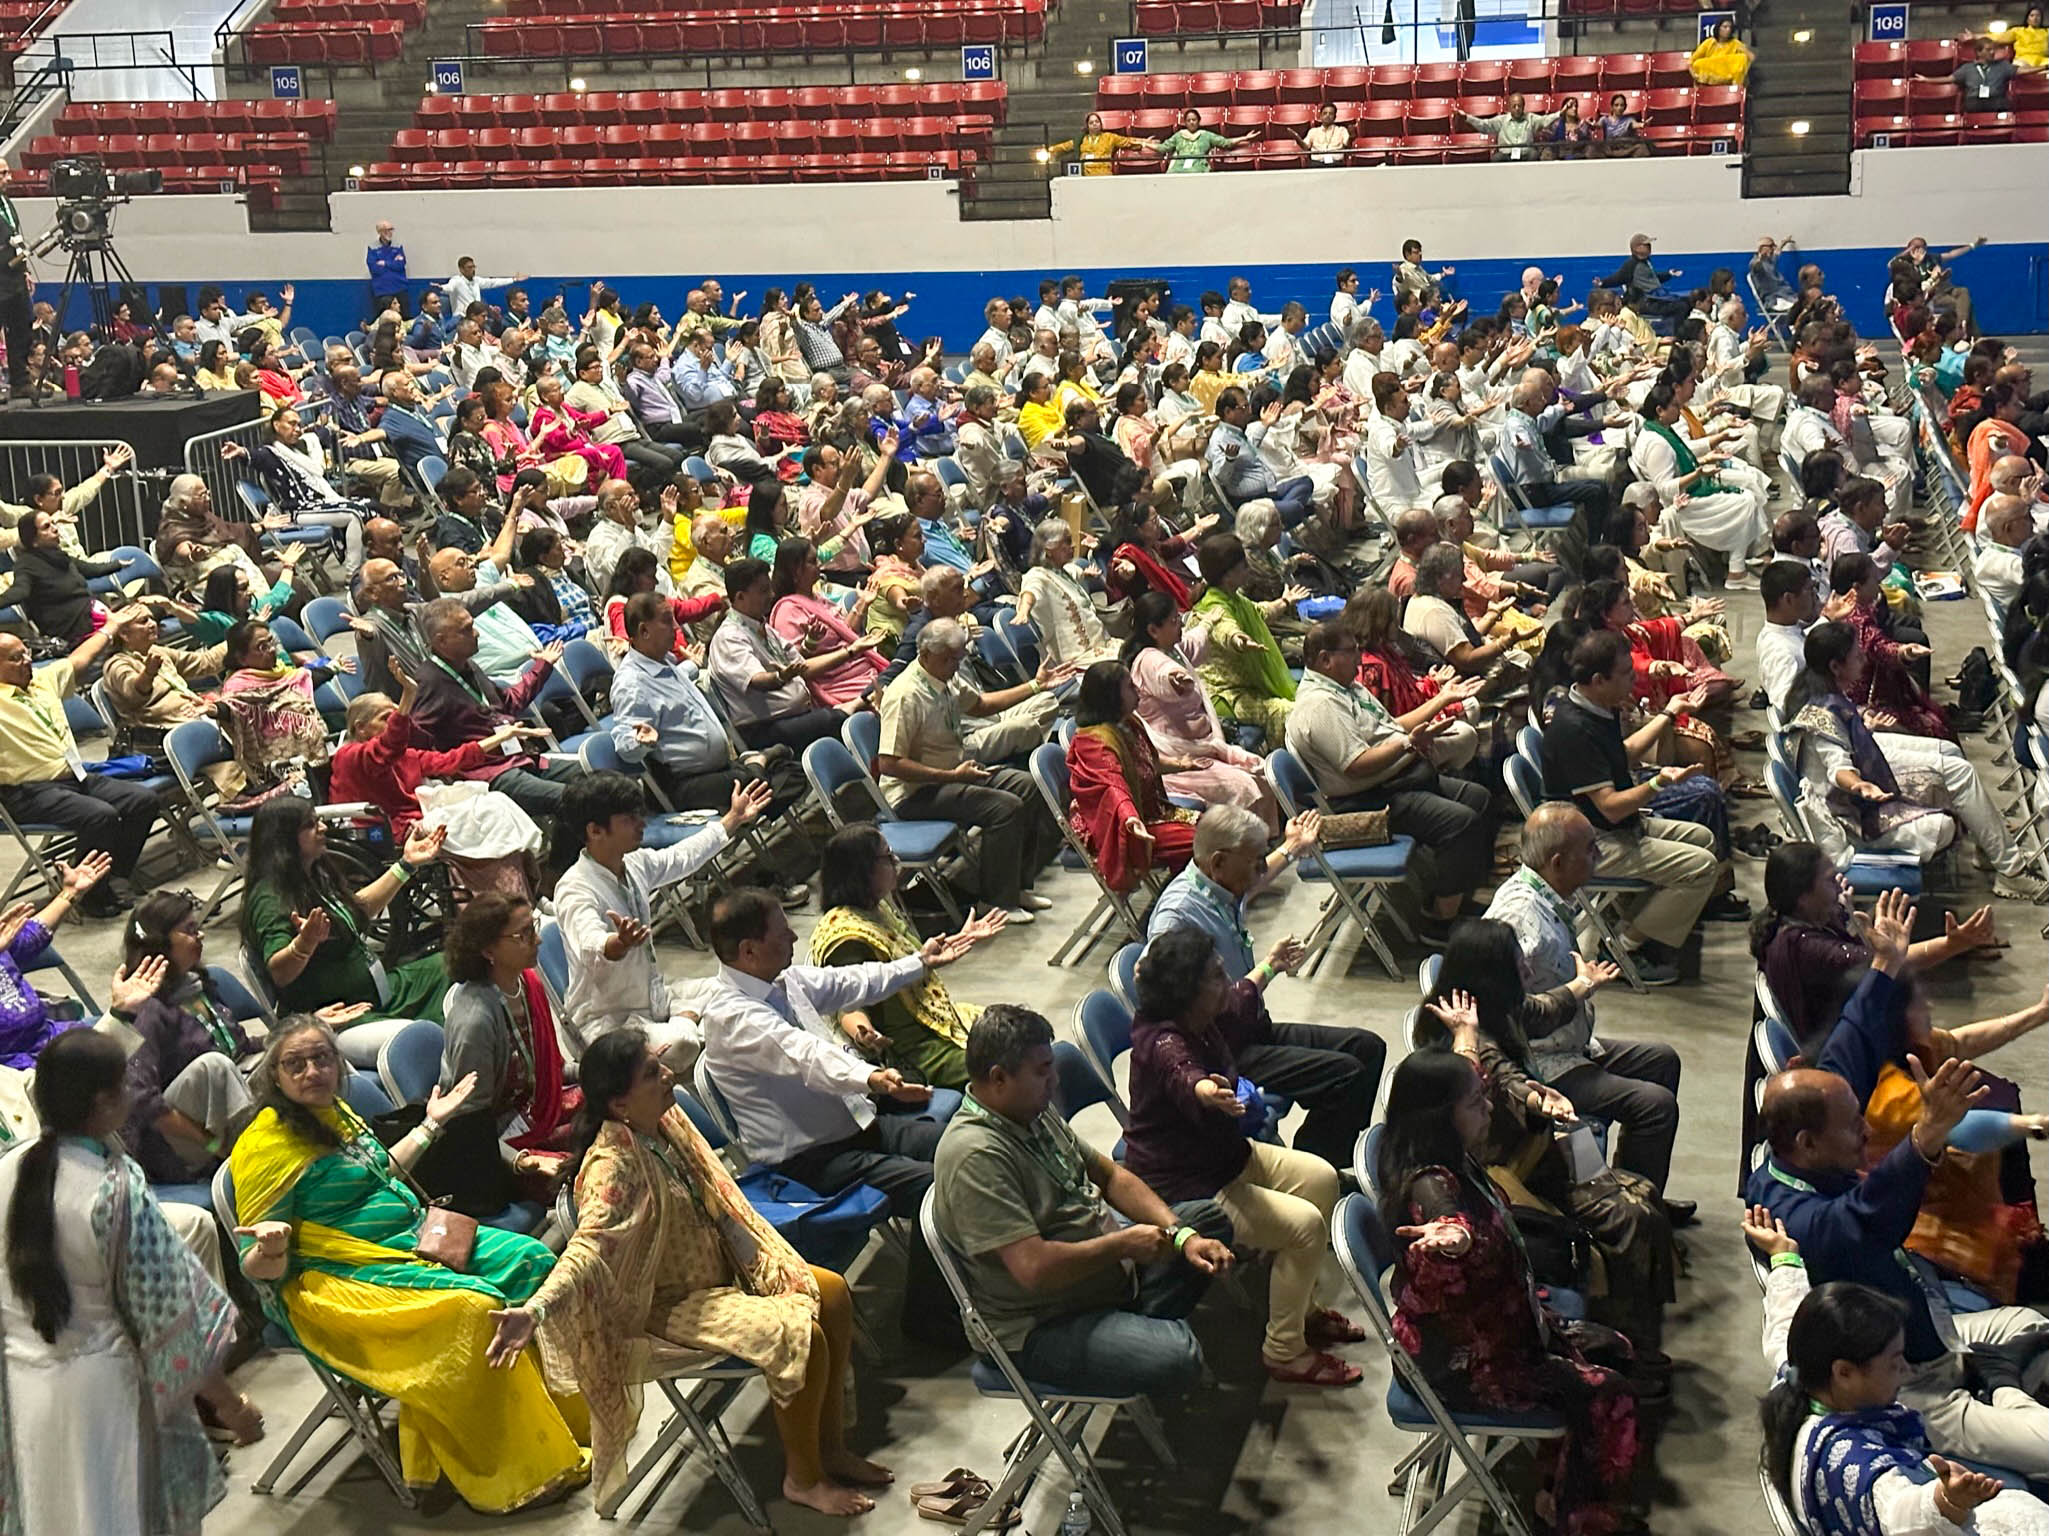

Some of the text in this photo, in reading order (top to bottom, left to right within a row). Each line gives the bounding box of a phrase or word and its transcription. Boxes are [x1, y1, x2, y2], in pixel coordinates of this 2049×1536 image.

[1875, 16, 1903, 30] 108
[966, 58, 990, 71] 106
[276, 77, 297, 89] 105
[438, 72, 460, 85] 106
